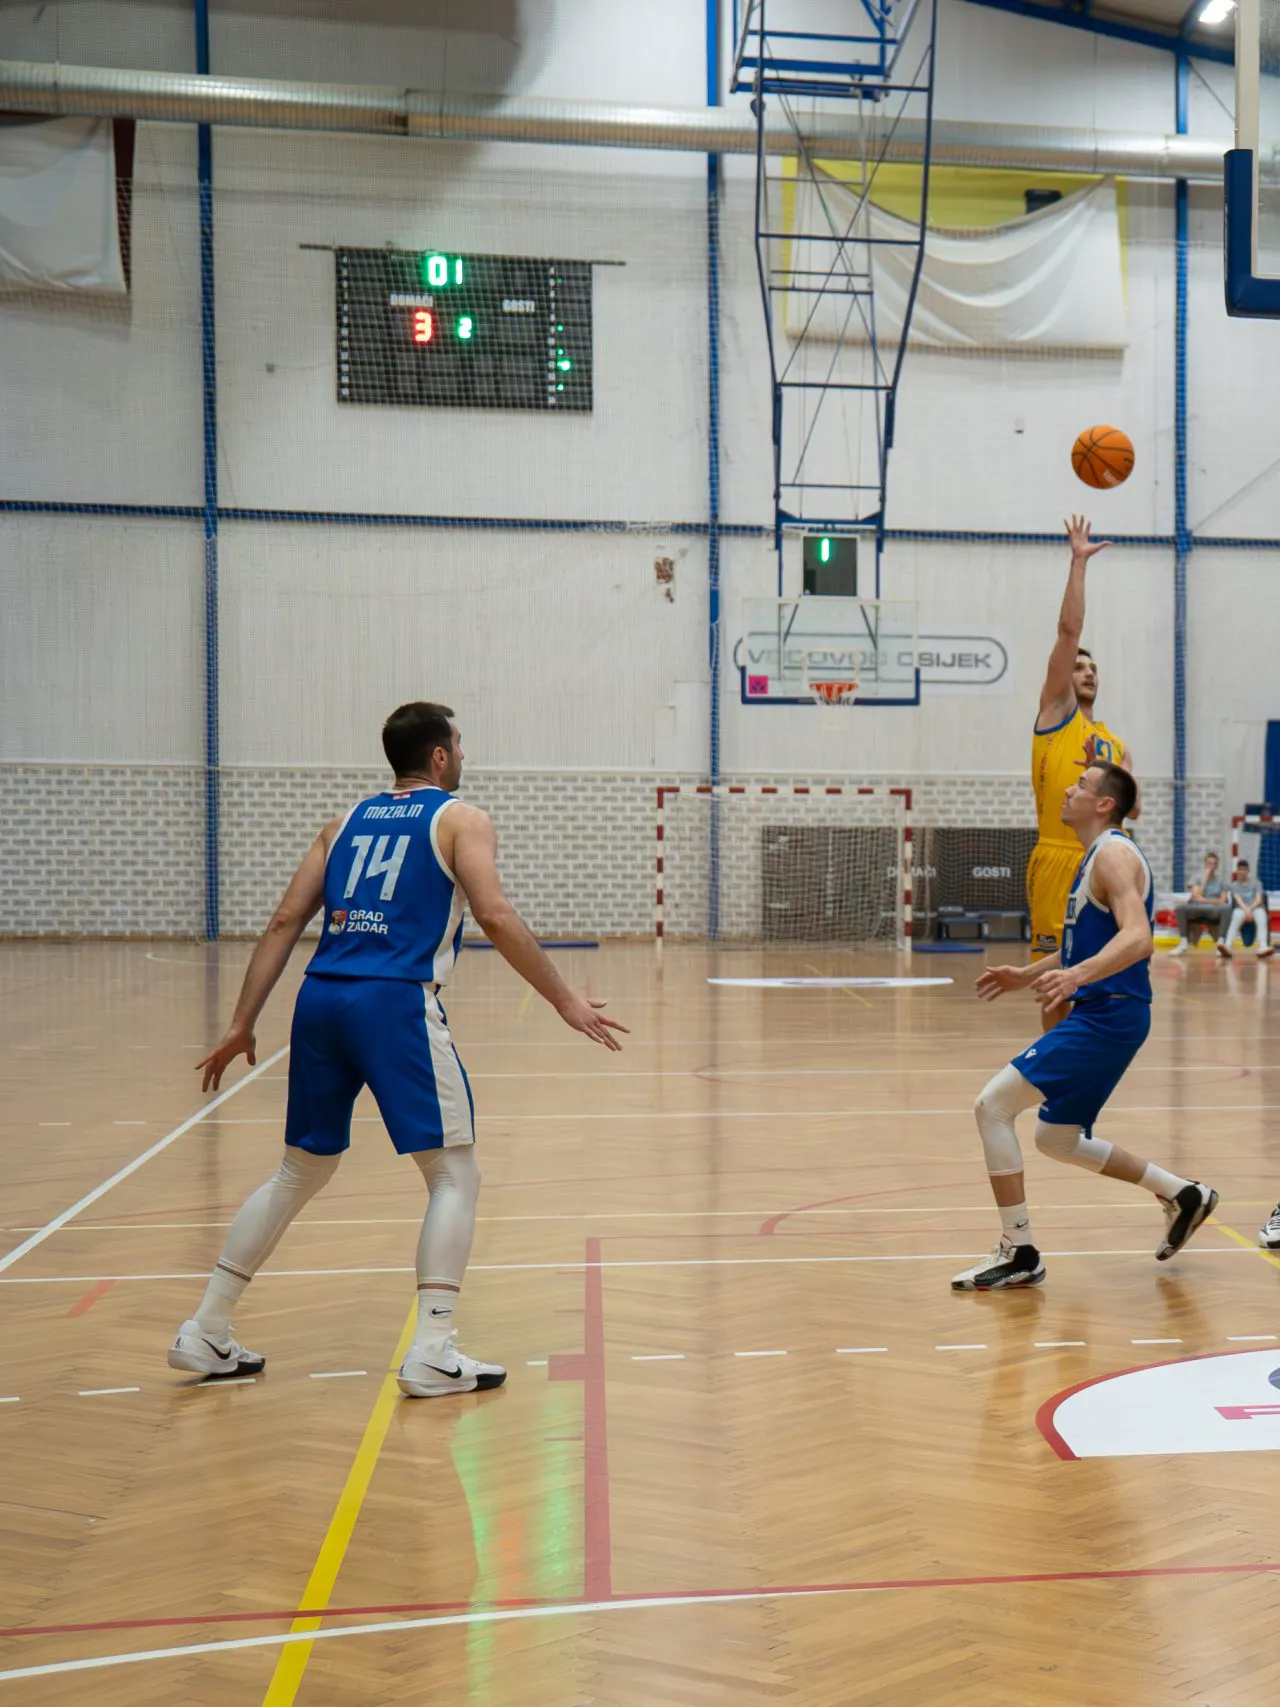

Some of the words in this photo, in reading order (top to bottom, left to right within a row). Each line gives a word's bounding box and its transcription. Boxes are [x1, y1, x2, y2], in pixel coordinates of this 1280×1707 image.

[415, 311, 432, 342] 3
[363, 804, 424, 819] MAZALIN
[343, 835, 411, 901] 14
[349, 909, 384, 922] GRAD
[347, 921, 389, 935] ZADAR
